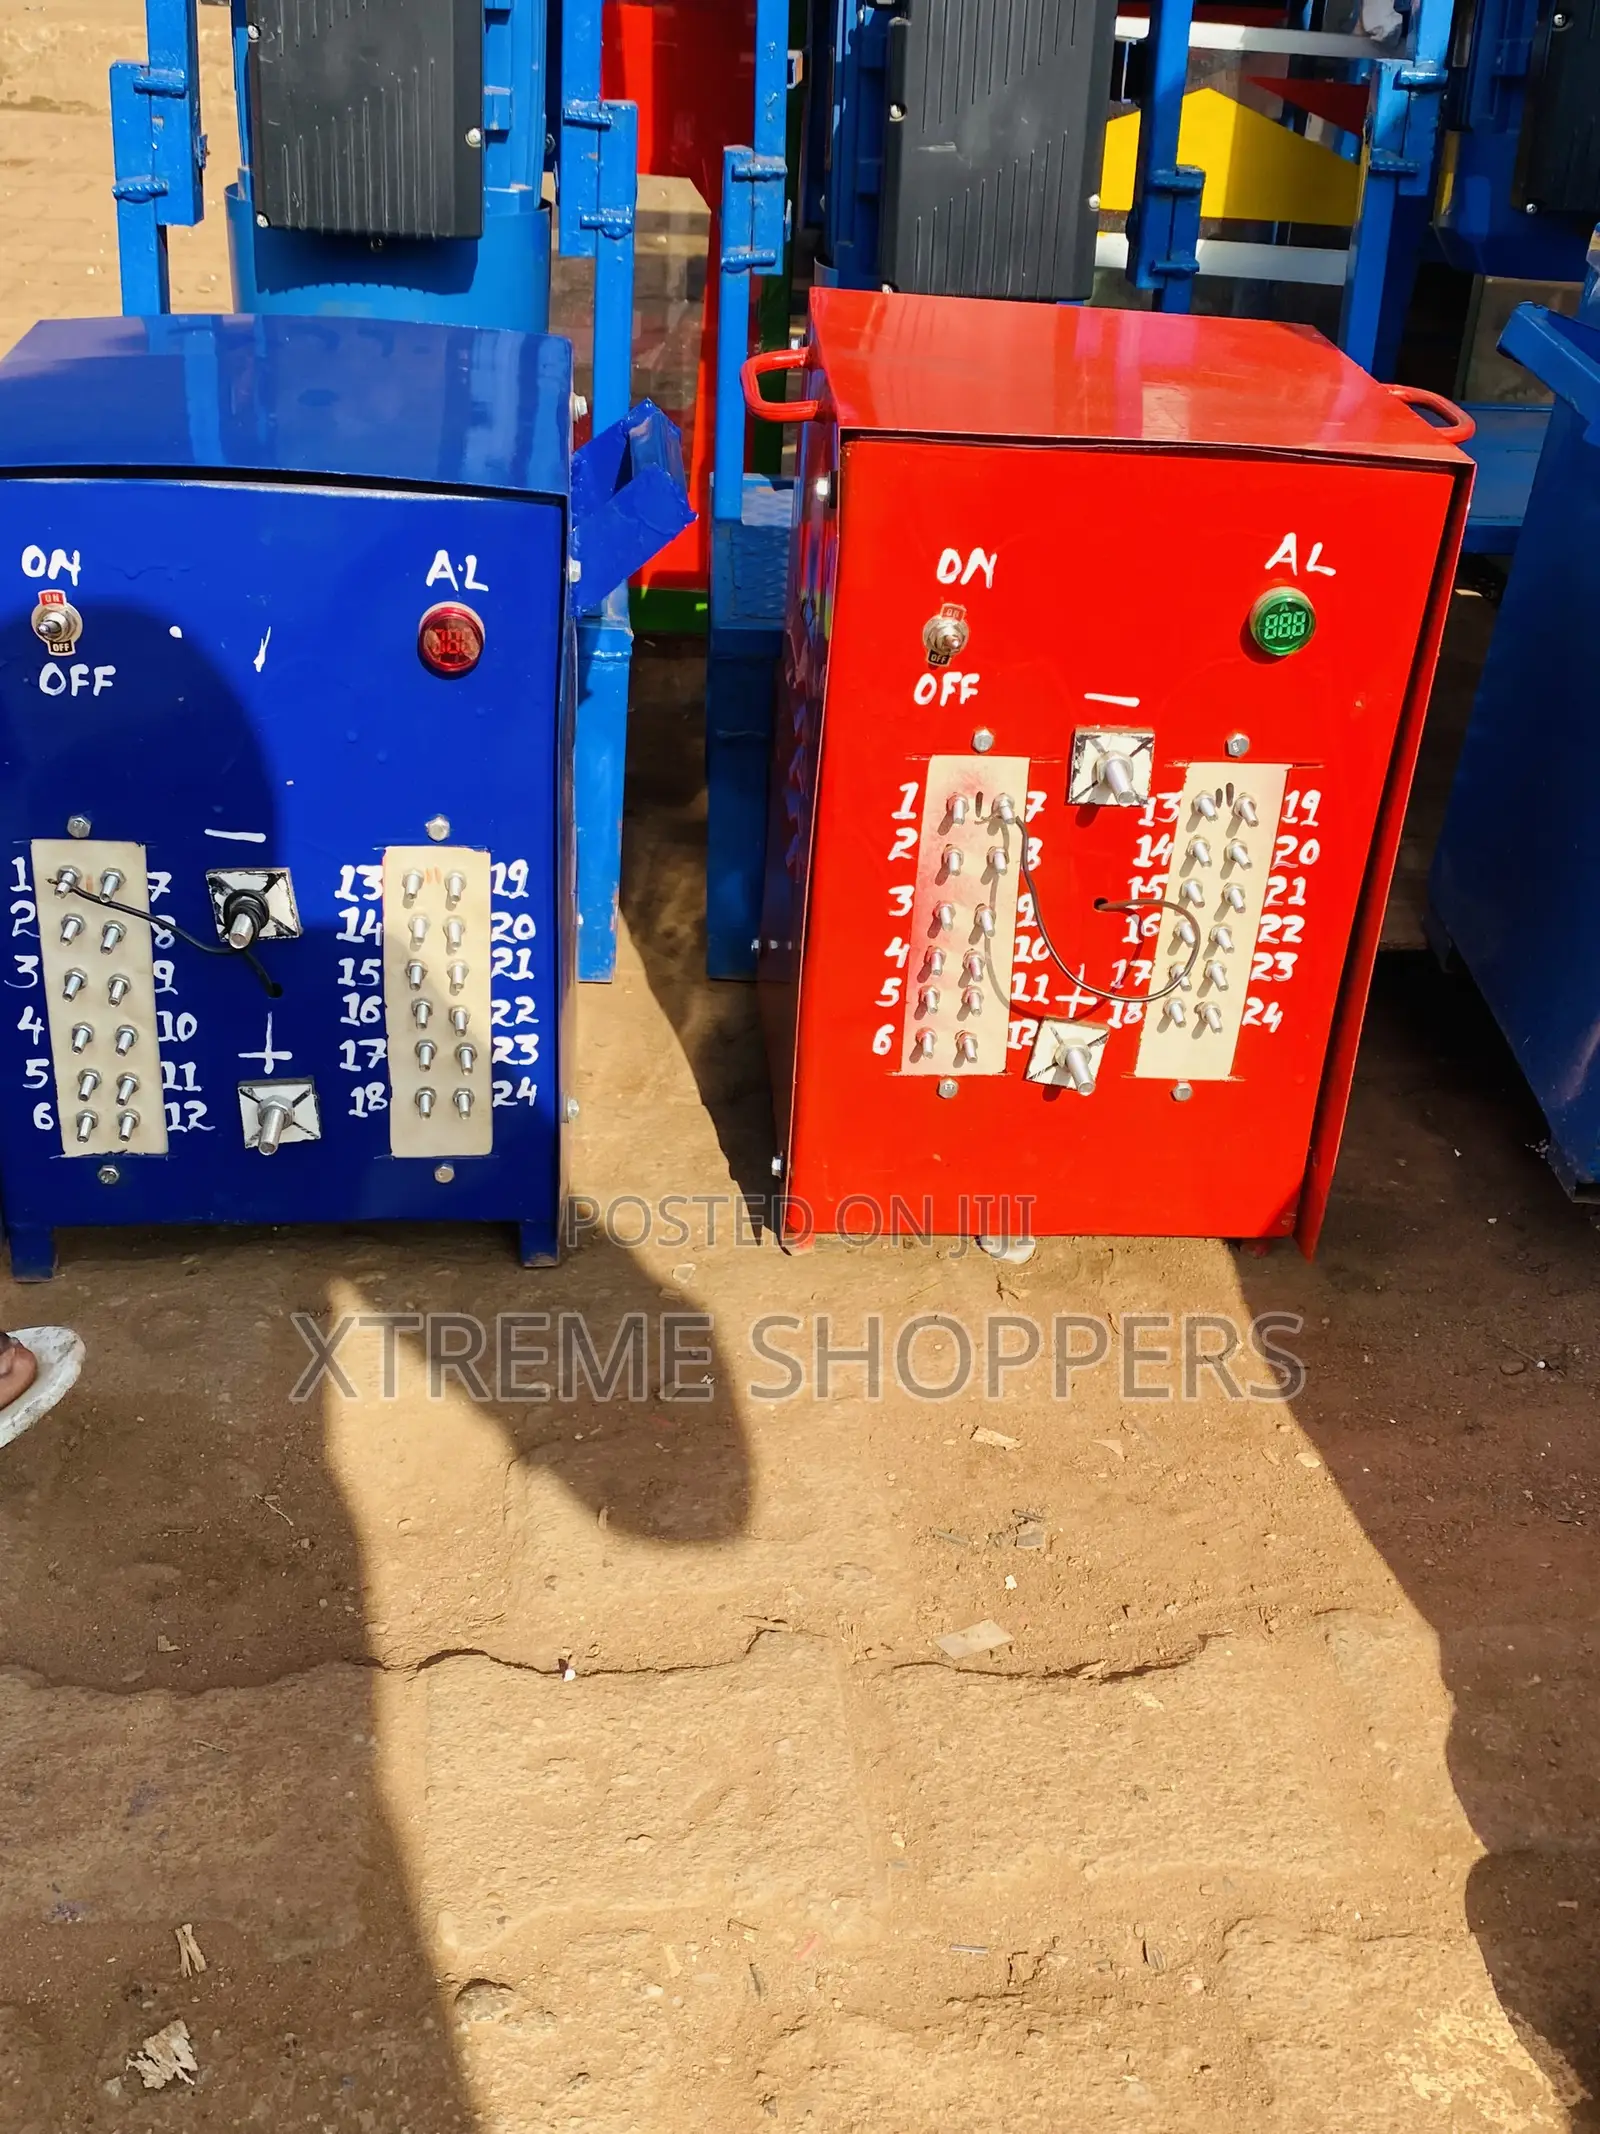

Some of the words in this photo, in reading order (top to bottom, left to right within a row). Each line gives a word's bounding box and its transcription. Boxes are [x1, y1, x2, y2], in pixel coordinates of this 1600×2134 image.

[21, 544, 81, 587] ON
[936, 547, 997, 589] ON
[44, 593, 61, 603] ON
[52, 641, 70, 653] OFF
[930, 653, 947, 664] OFF
[39, 661, 116, 697] OFF
[913, 671, 980, 706] OFF
[891, 782, 918, 820] 1
[1025, 791, 1048, 823] 7
[1138, 791, 1183, 827] 13
[1282, 789, 1322, 827] 19
[888, 827, 918, 860] 2
[1132, 833, 1174, 868] 14
[1273, 835, 1321, 869] 20
[10, 856, 32, 891] 1
[147, 871, 172, 903] 7
[335, 865, 384, 902] 13
[491, 858, 529, 899] 19
[888, 885, 915, 917] 3
[1125, 873, 1169, 910] 15
[1265, 876, 1307, 906] 21
[10, 900, 40, 938] 2
[336, 907, 383, 946] 14
[491, 912, 536, 944] 20
[1121, 912, 1161, 945] 16
[1258, 913, 1306, 944] 22
[491, 948, 532, 981] 21
[884, 937, 910, 968] 4
[1013, 936, 1051, 963] 10
[4, 955, 39, 989] 3
[153, 960, 178, 995] 9
[338, 958, 382, 987] 15
[1111, 959, 1154, 989] 17
[1251, 952, 1299, 982] 23
[874, 977, 902, 1008] 5
[1010, 972, 1050, 1005] 11
[340, 993, 382, 1025] 16
[491, 996, 539, 1026] 22
[1107, 1000, 1143, 1030] 18
[1242, 997, 1283, 1034] 24
[17, 1006, 45, 1045] 4
[156, 1011, 198, 1042] 10
[872, 1024, 895, 1055] 6
[339, 1038, 388, 1071] 17
[492, 1034, 539, 1066] 23
[23, 1059, 49, 1089] 5
[160, 1062, 203, 1092] 11
[349, 1082, 388, 1118] 18
[492, 1077, 538, 1107] 24
[33, 1102, 54, 1131] 6
[164, 1101, 215, 1132] 12
